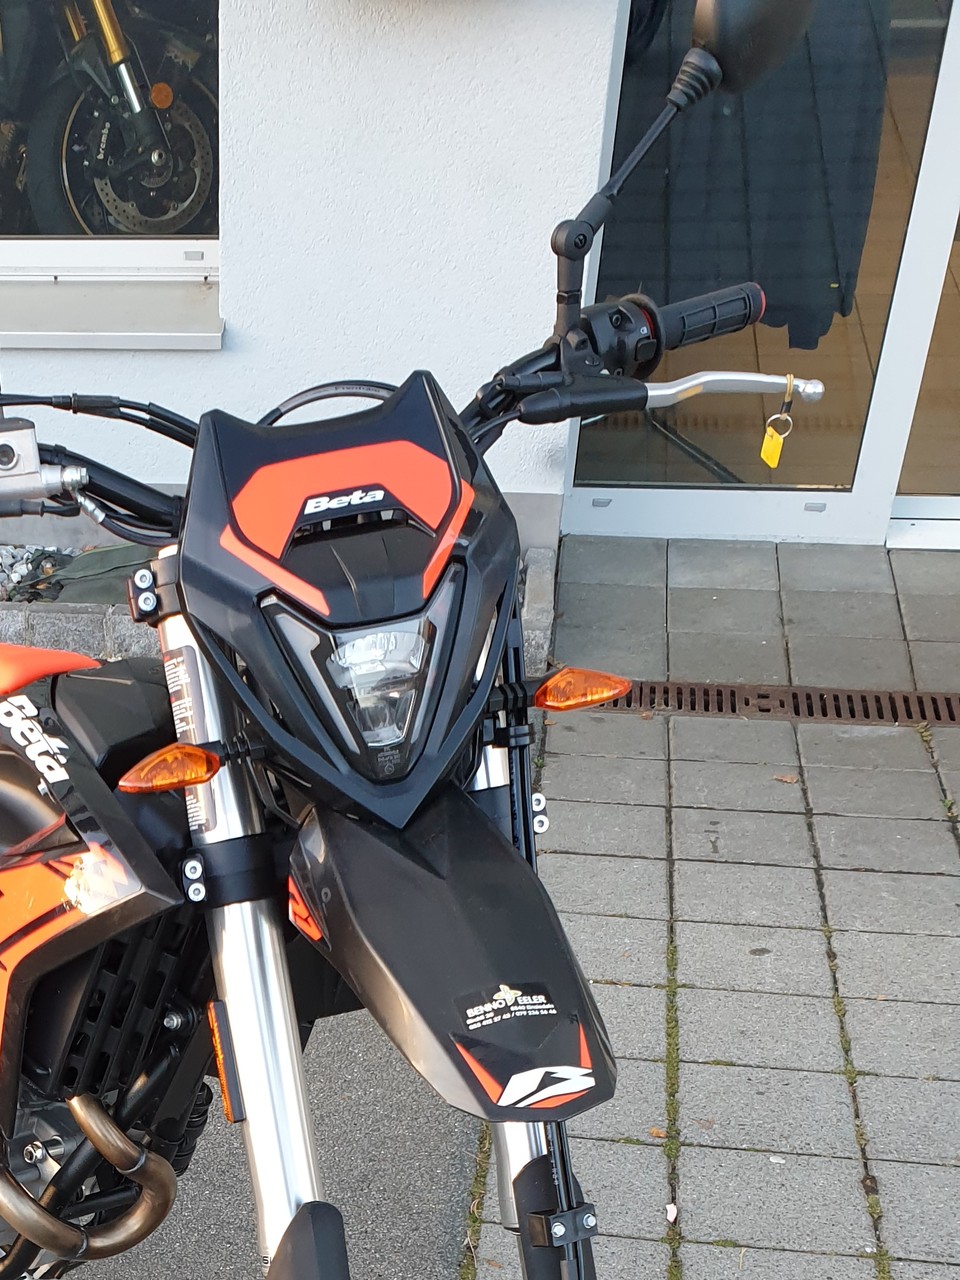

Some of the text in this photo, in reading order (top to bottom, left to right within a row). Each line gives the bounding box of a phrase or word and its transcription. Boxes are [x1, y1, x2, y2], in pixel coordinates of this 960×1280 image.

[97, 121, 110, 159] brembo
[304, 490, 385, 515] Beta
[466, 1000, 506, 1018] BENNO
